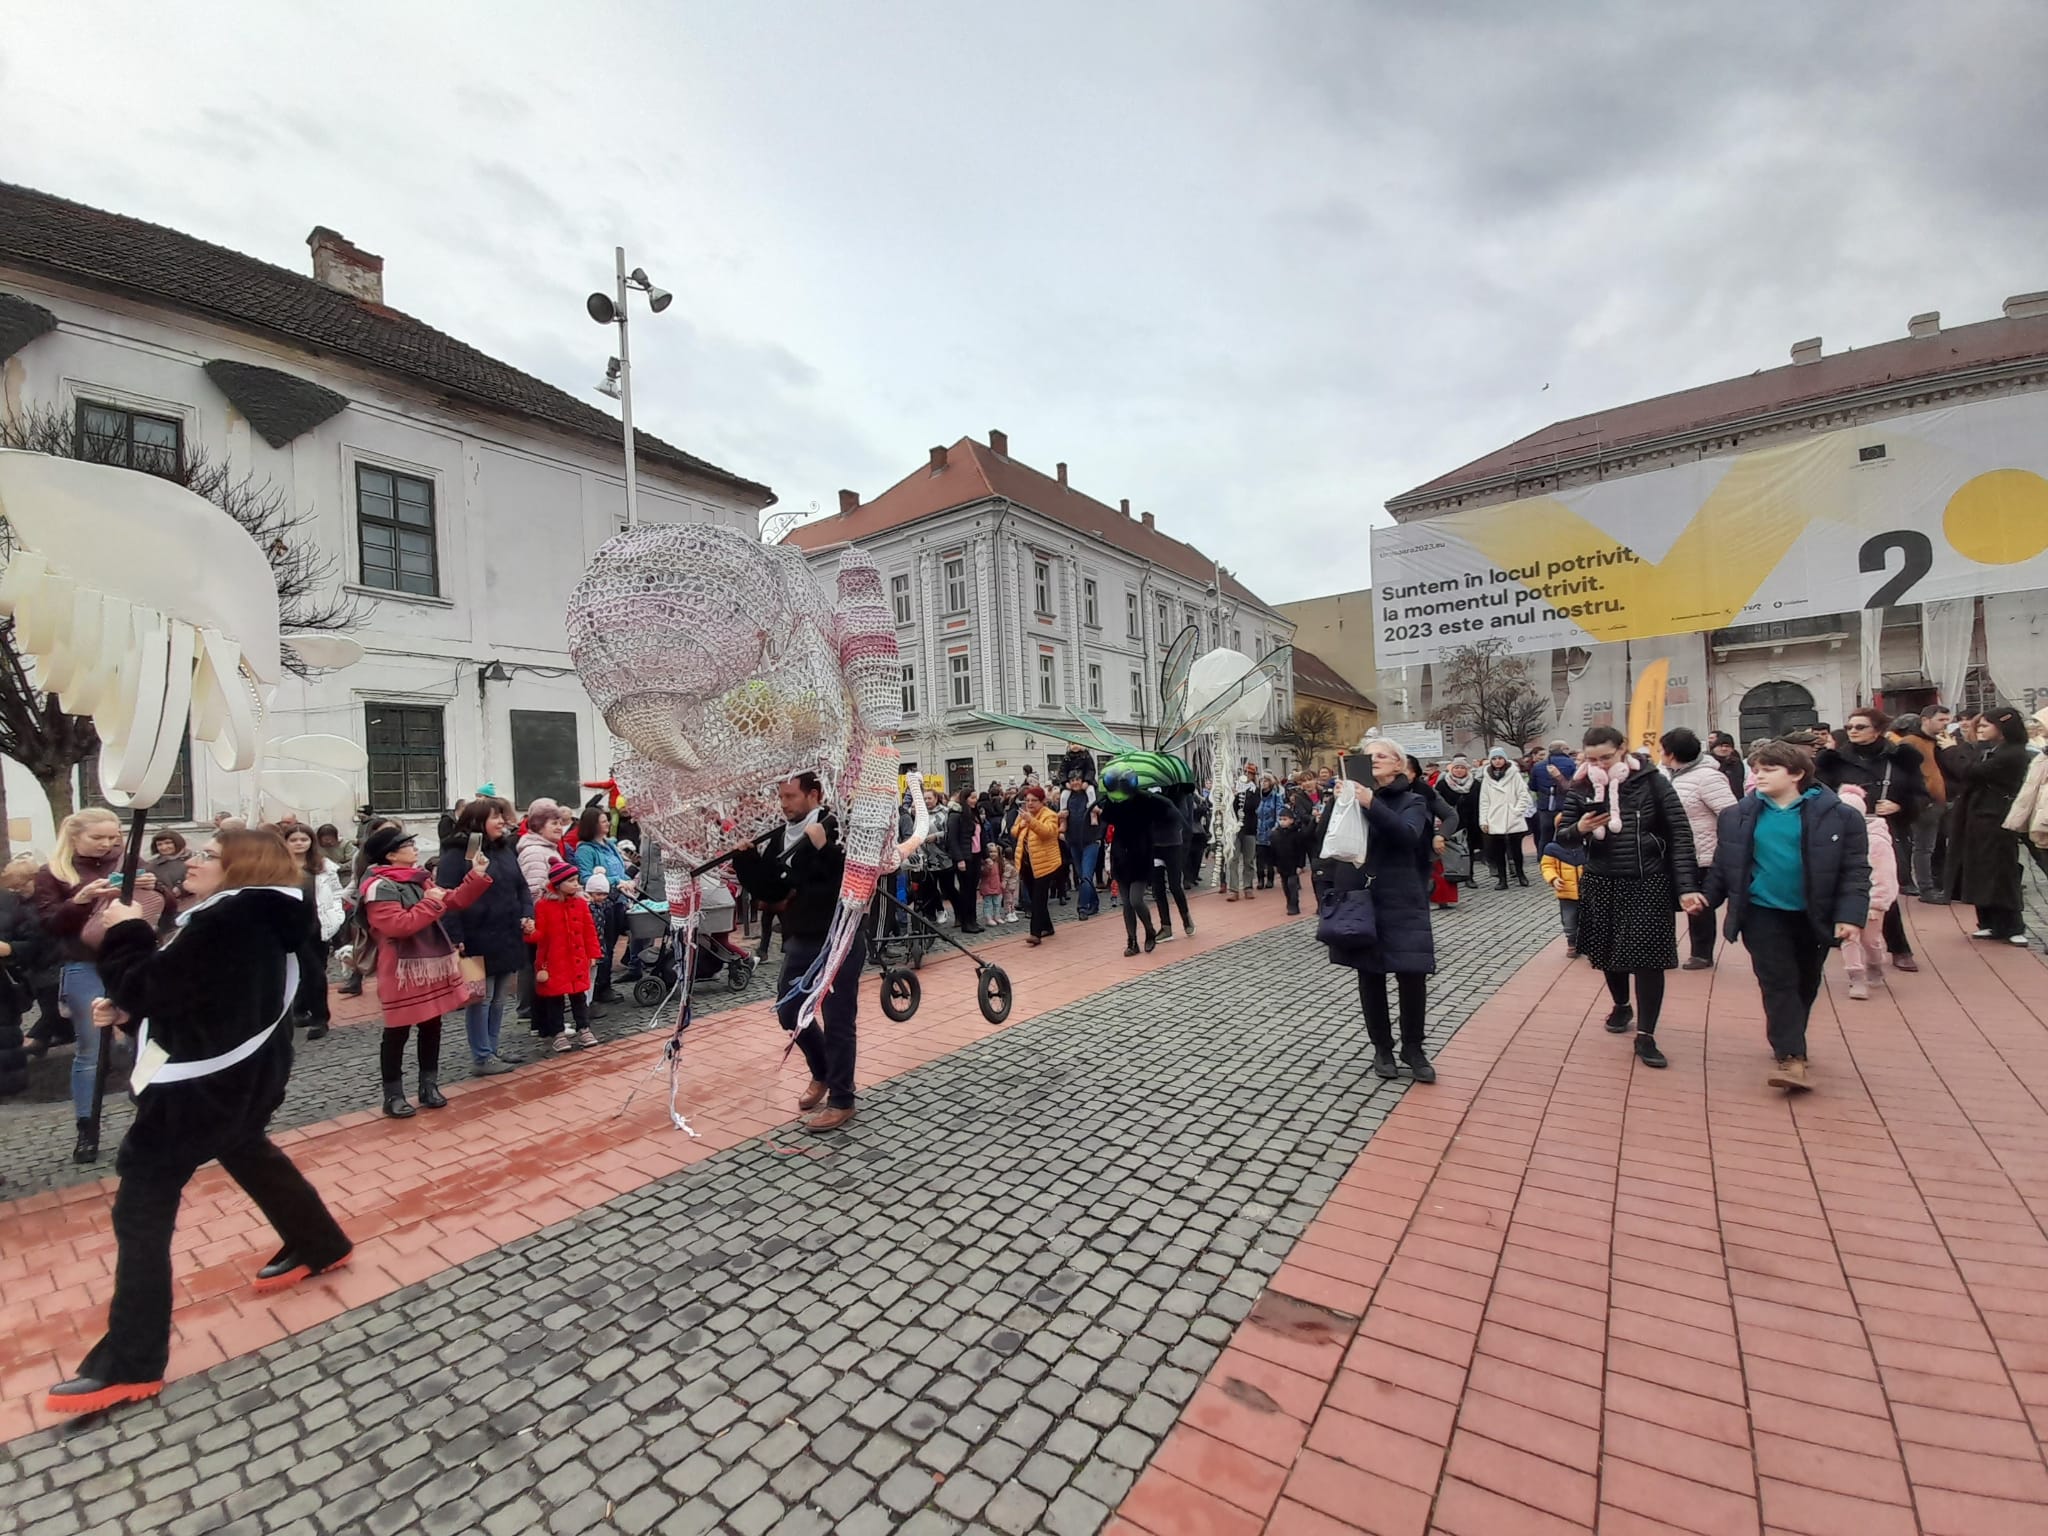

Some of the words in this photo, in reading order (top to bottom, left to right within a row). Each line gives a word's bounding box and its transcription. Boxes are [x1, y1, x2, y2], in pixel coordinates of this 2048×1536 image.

[1382, 579, 1459, 601] Suntem
[1464, 572, 1483, 588] în
[1489, 561, 1540, 585] locul
[1547, 546, 1640, 580] potrivit,
[1383, 607, 1398, 622] la
[1405, 588, 1508, 618] momentul
[1515, 575, 1605, 607] potrivit.
[1384, 622, 1433, 642] 2023
[1438, 617, 1484, 635] este
[1490, 607, 1536, 628] anul
[1542, 599, 1625, 621] nostru.
